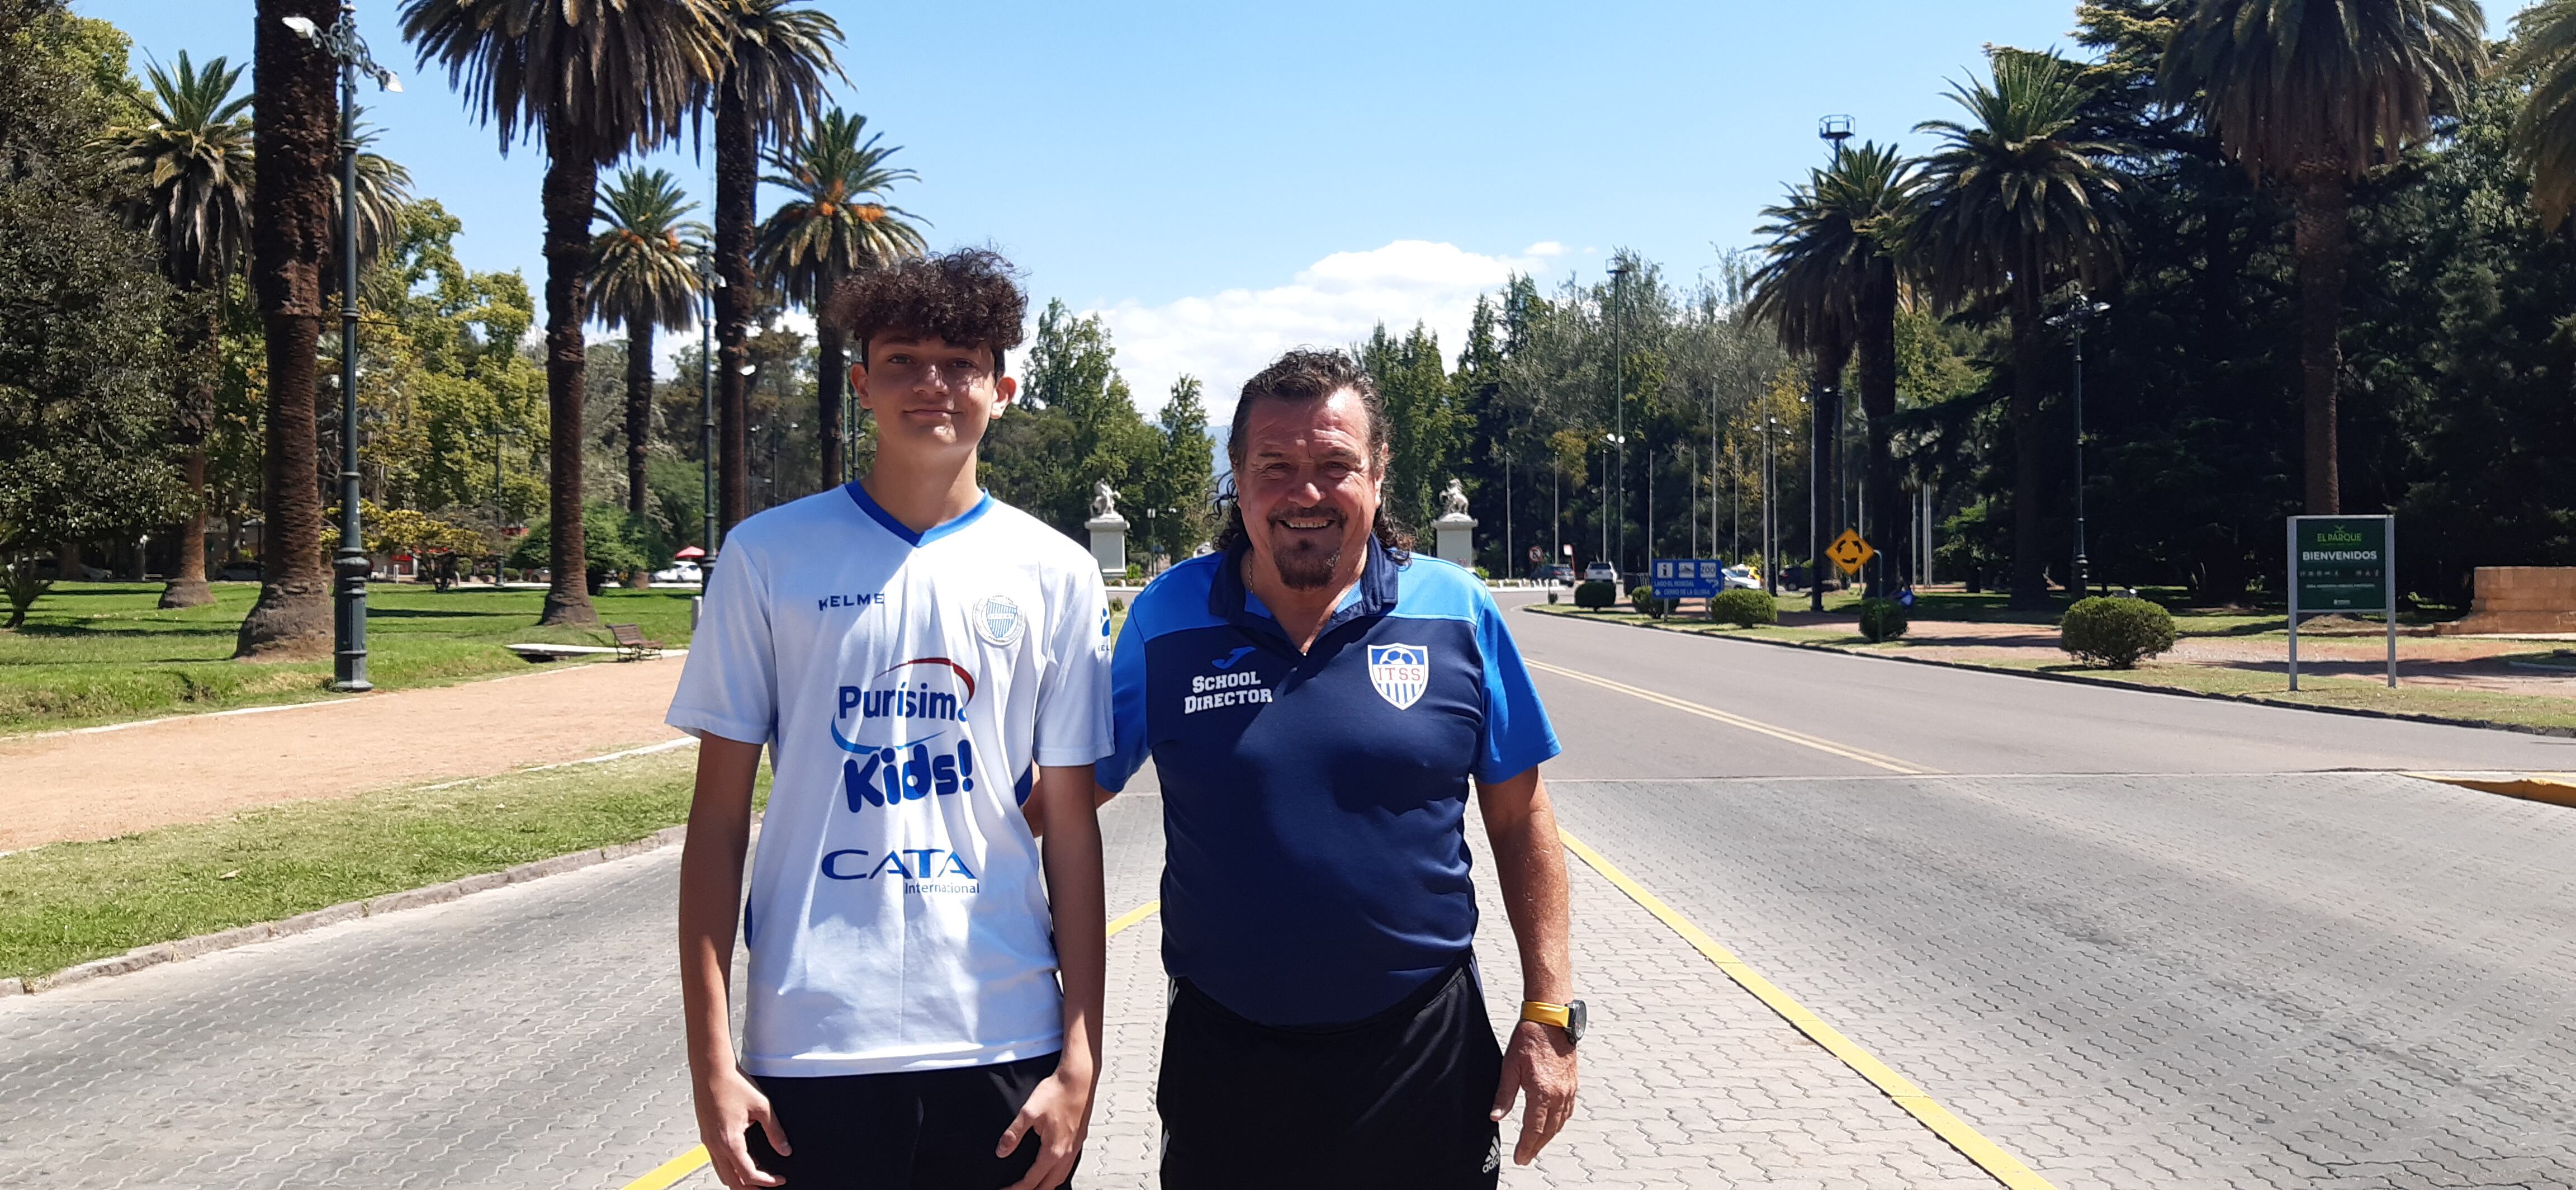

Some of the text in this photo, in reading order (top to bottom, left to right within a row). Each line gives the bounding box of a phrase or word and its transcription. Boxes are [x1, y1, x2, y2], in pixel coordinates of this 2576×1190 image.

[2317, 533, 2326, 542] EL
[2303, 551, 2377, 560] BIENVENIDOS
[818, 593, 885, 611] KELME
[1379, 668, 1420, 681] ITSS
[844, 739, 974, 813] Kids!
[821, 849, 978, 880] CATA
[905, 882, 979, 894] International
